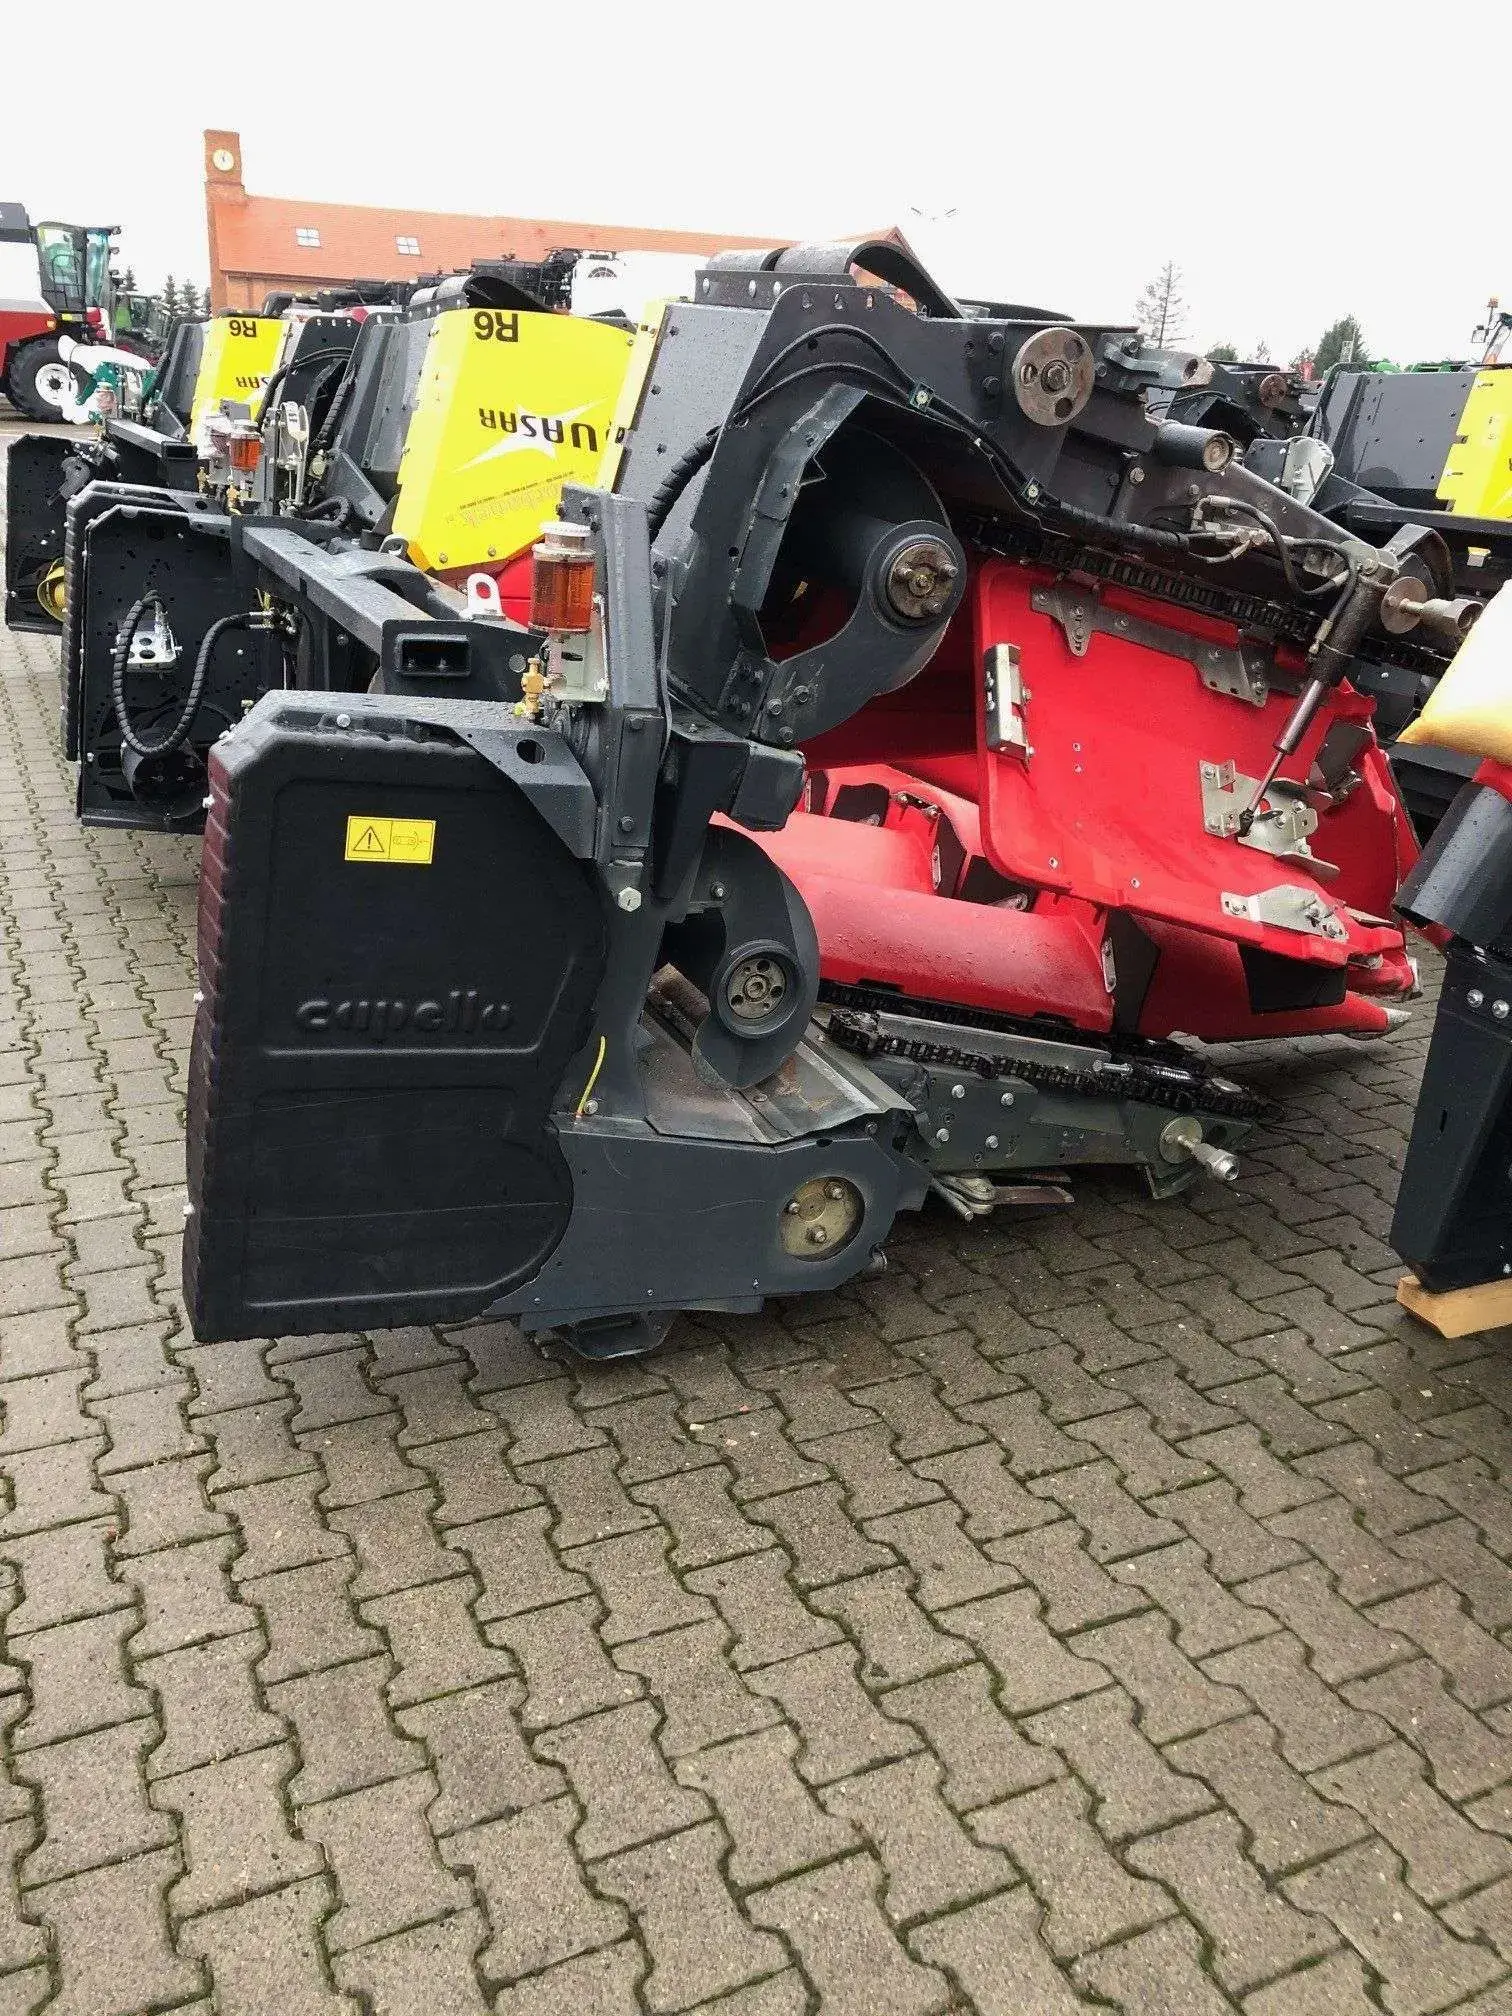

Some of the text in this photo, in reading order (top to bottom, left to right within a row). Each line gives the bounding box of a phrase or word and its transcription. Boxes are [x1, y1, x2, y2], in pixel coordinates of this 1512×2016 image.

[229, 319, 257, 338] R6
[473, 311, 519, 342] R6
[479, 408, 612, 452] UASAR
